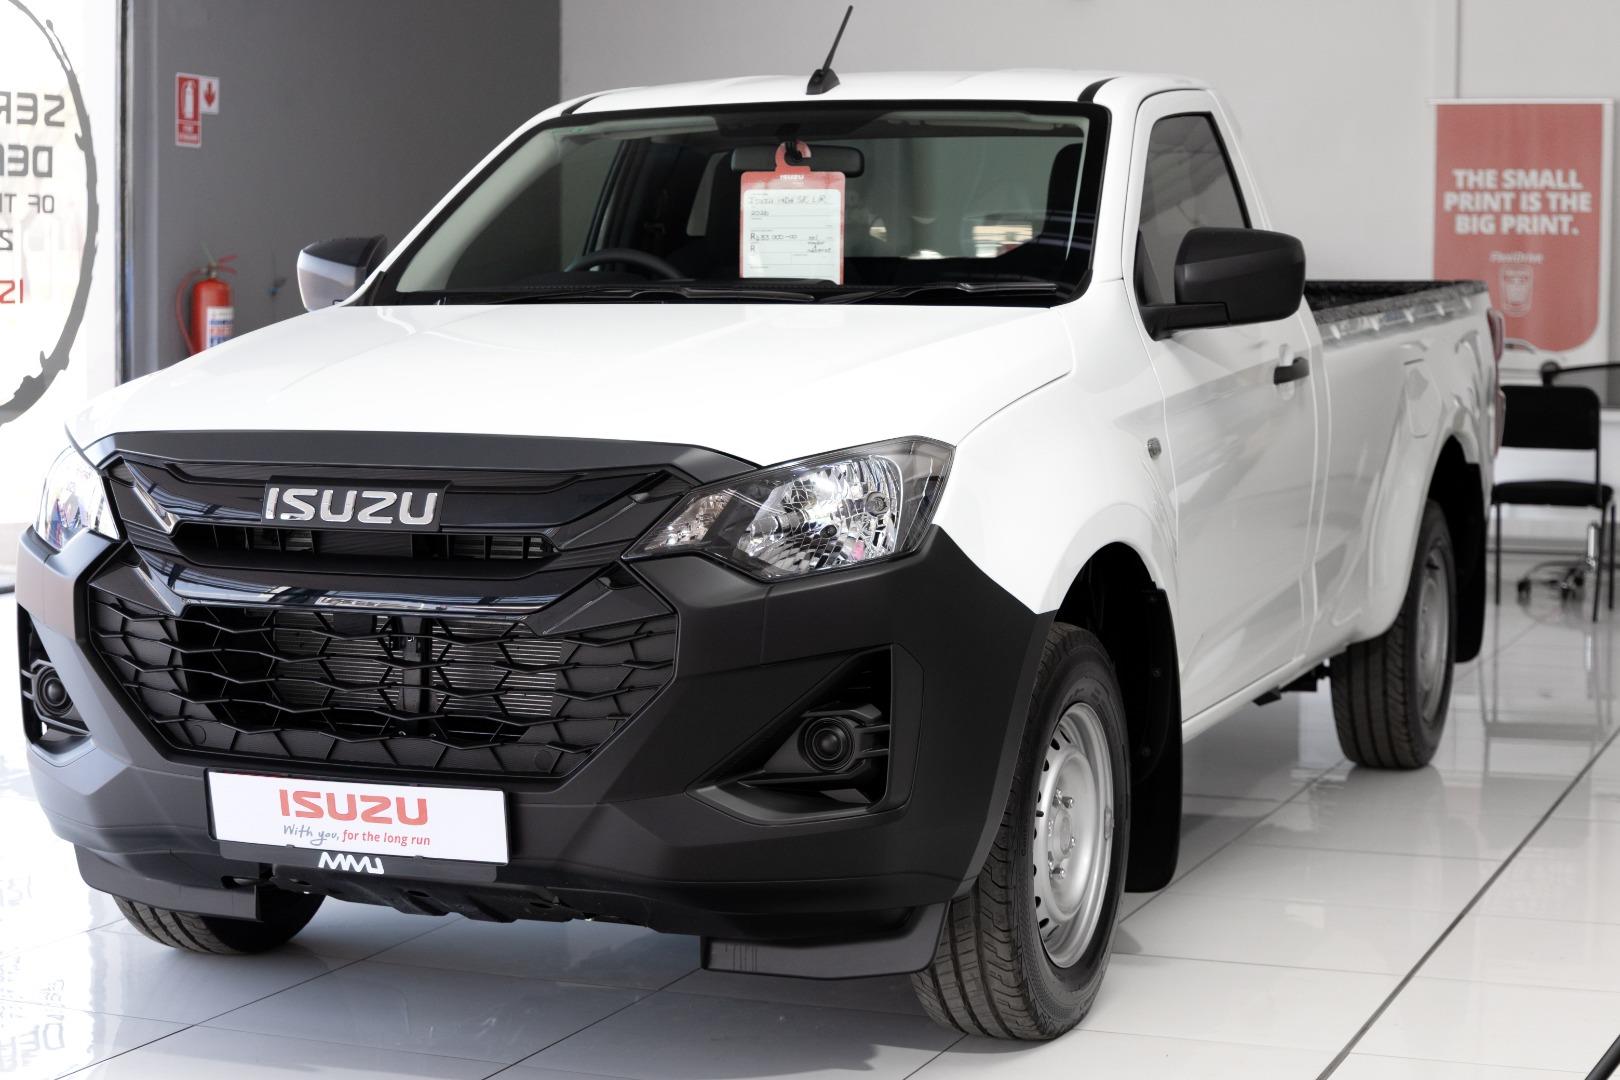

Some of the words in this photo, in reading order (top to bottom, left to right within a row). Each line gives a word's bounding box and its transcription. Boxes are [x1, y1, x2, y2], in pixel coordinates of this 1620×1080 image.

[1453, 168, 1498, 189] THE
[1502, 168, 1584, 190] SMALL
[1443, 191, 1516, 212] PRINT
[1519, 191, 1543, 212] IS
[1546, 191, 1593, 213] THE
[1455, 214, 1496, 235] BIG
[1501, 214, 1580, 236] PRINT.
[265, 488, 438, 525] ISUZU
[279, 789, 428, 826] ISUZU
[283, 824, 313, 839] With
[310, 830, 340, 846] you,
[342, 829, 359, 842] for
[362, 830, 381, 842] the
[383, 832, 408, 847] long
[411, 836, 431, 846] run
